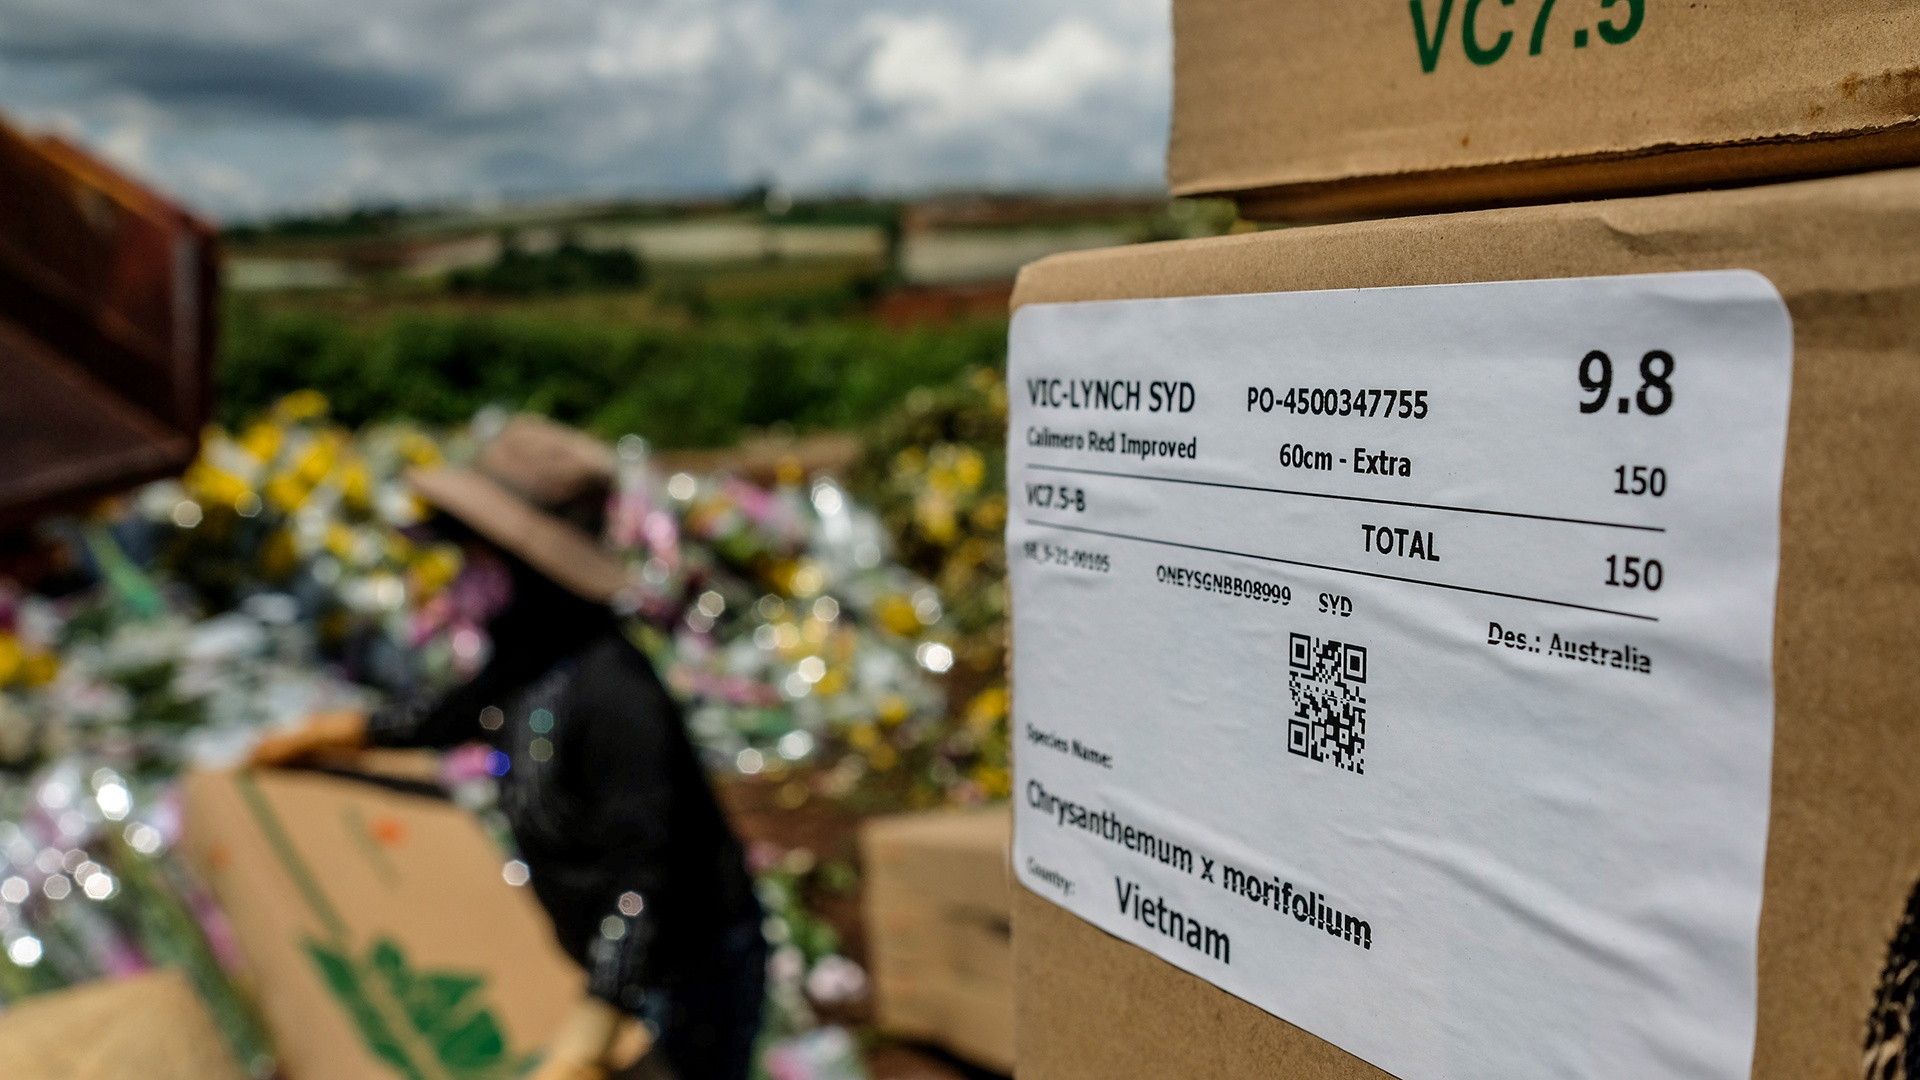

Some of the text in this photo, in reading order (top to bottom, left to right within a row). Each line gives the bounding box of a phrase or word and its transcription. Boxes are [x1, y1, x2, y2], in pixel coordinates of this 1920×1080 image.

[1026, 379, 1196, 413] VIC-LYNCH SYD
[1578, 350, 1676, 416] 9.8
[1247, 386, 1429, 420] PO-4500347755
[1026, 426, 1197, 460] Calimero Red Improved
[1279, 444, 1333, 471] 60cm
[1353, 448, 1412, 477] Extra
[1025, 483, 1086, 512] VC7.5-B
[1614, 466, 1666, 497] 150
[1361, 524, 1440, 562] TOTAL
[1604, 555, 1664, 591] 150
[1318, 592, 1353, 618] SYD
[1487, 621, 1653, 675] Des.: Australia
[1026, 722, 1113, 769] Species Name:
[1026, 779, 1373, 950] Chrysanthemum x morifolium
[1026, 856, 1076, 897] Country:
[1115, 876, 1231, 964] Vietnam
